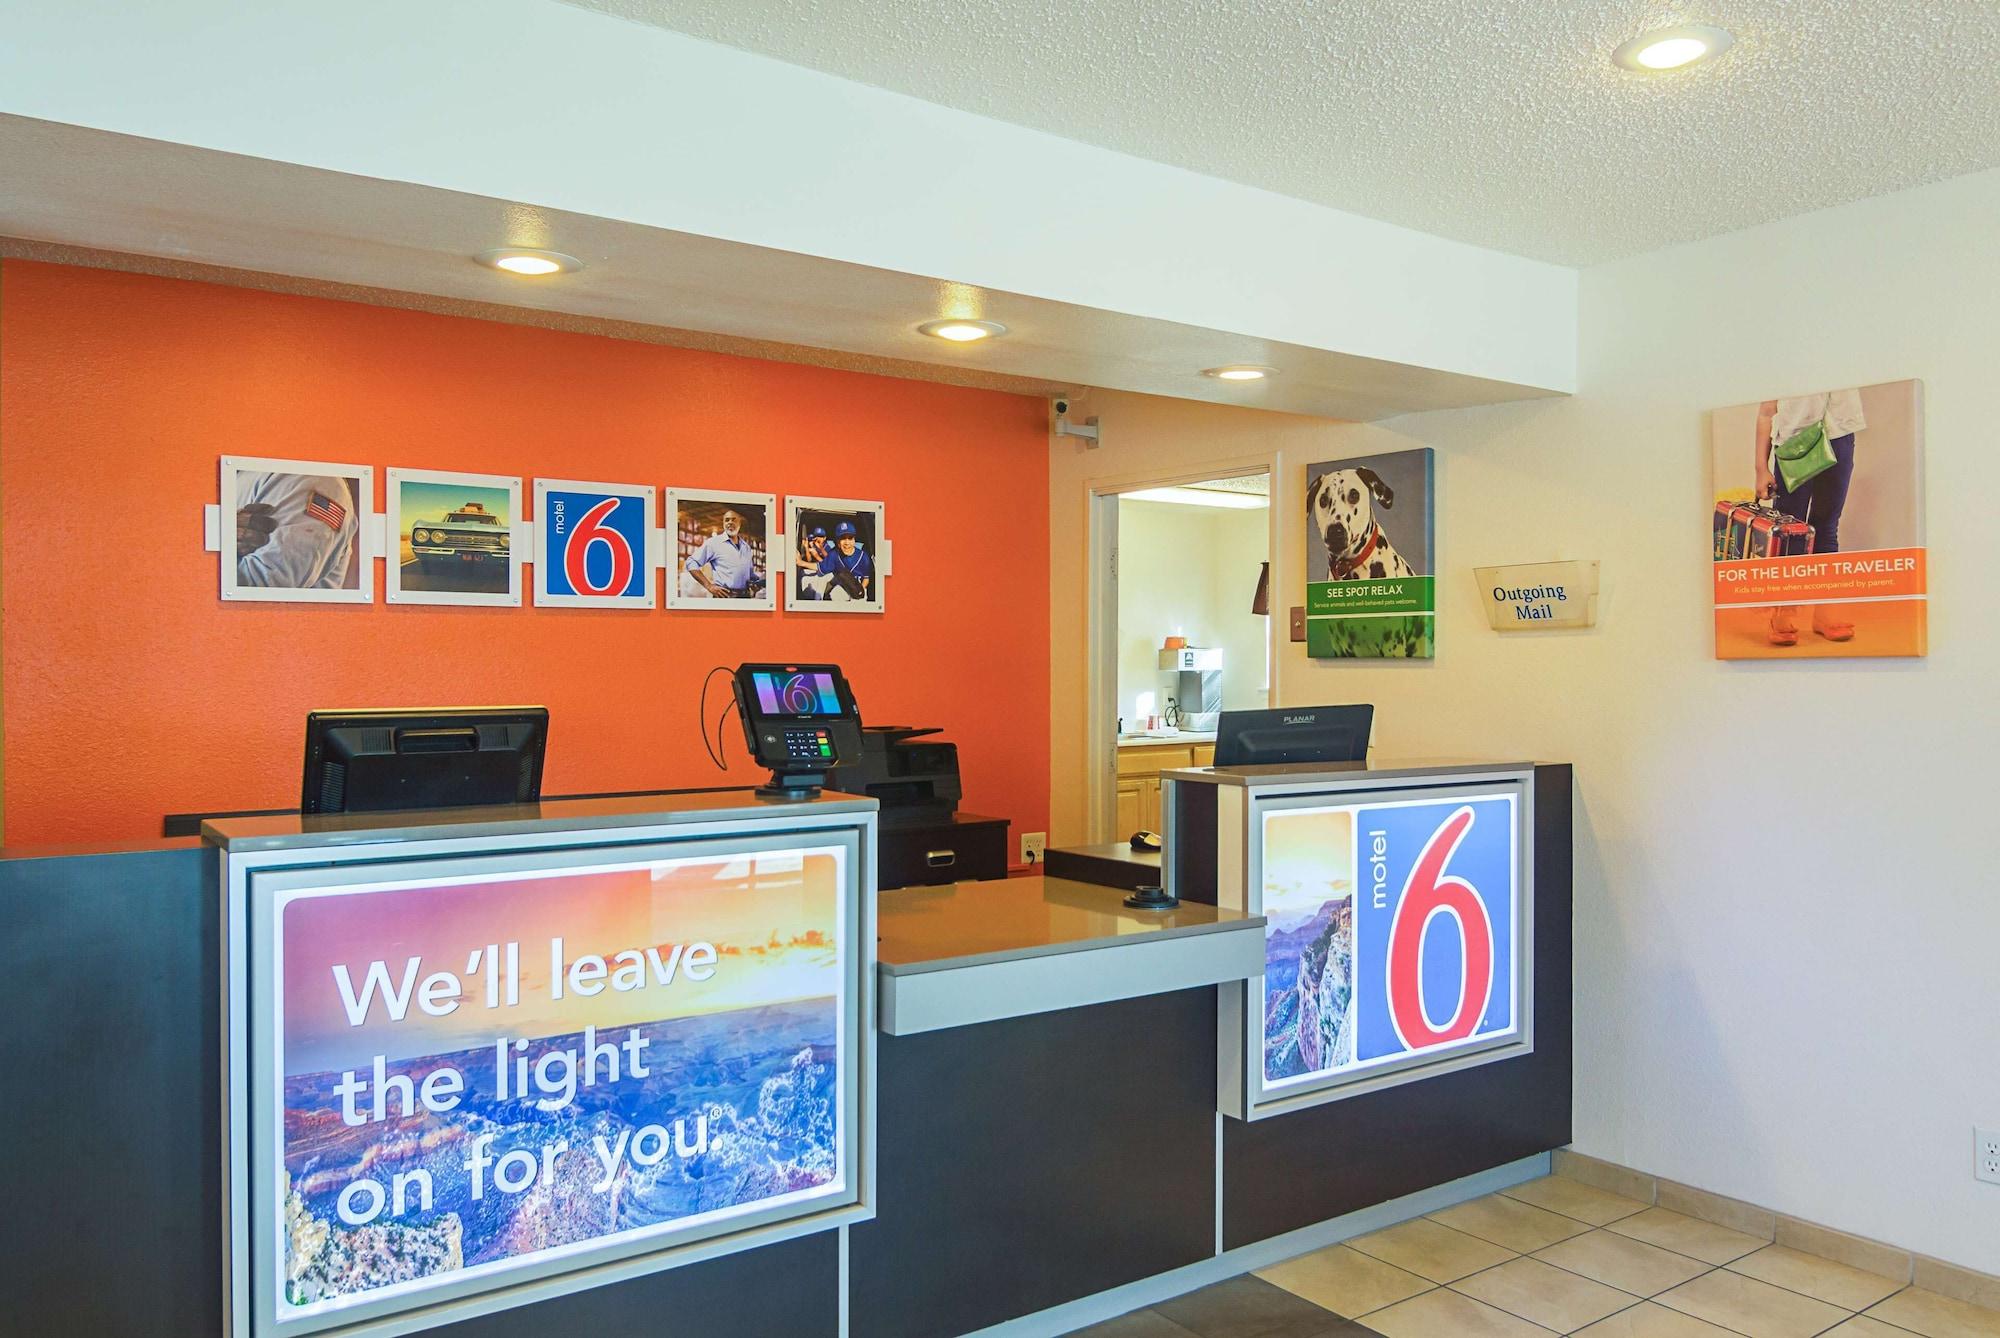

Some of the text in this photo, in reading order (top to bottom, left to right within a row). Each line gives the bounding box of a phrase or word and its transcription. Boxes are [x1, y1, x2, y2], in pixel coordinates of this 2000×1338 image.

[553, 497, 634, 597] motel 6
[1718, 557, 1915, 582] FOR THE LIGHT TRAVELER
[1327, 584, 1403, 598] SEE SPOT RELAX
[1493, 584, 1567, 603] Outgoing
[1734, 585, 1751, 593] Kids
[1752, 585, 1765, 594] stay
[1767, 584, 1781, 592] free
[1783, 583, 1802, 591] when
[1804, 580, 1854, 591] accompanied
[1856, 579, 1866, 588] by
[1516, 604, 1552, 620] Mail
[783, 674, 817, 713] 6
[1284, 714, 1316, 722] PLANAR
[1369, 805, 1494, 1052] motel 6
[332, 937, 718, 1027] We'll leave
[333, 1025, 651, 1128] the light
[336, 1164, 433, 1226] on
[464, 1132, 568, 1201] for
